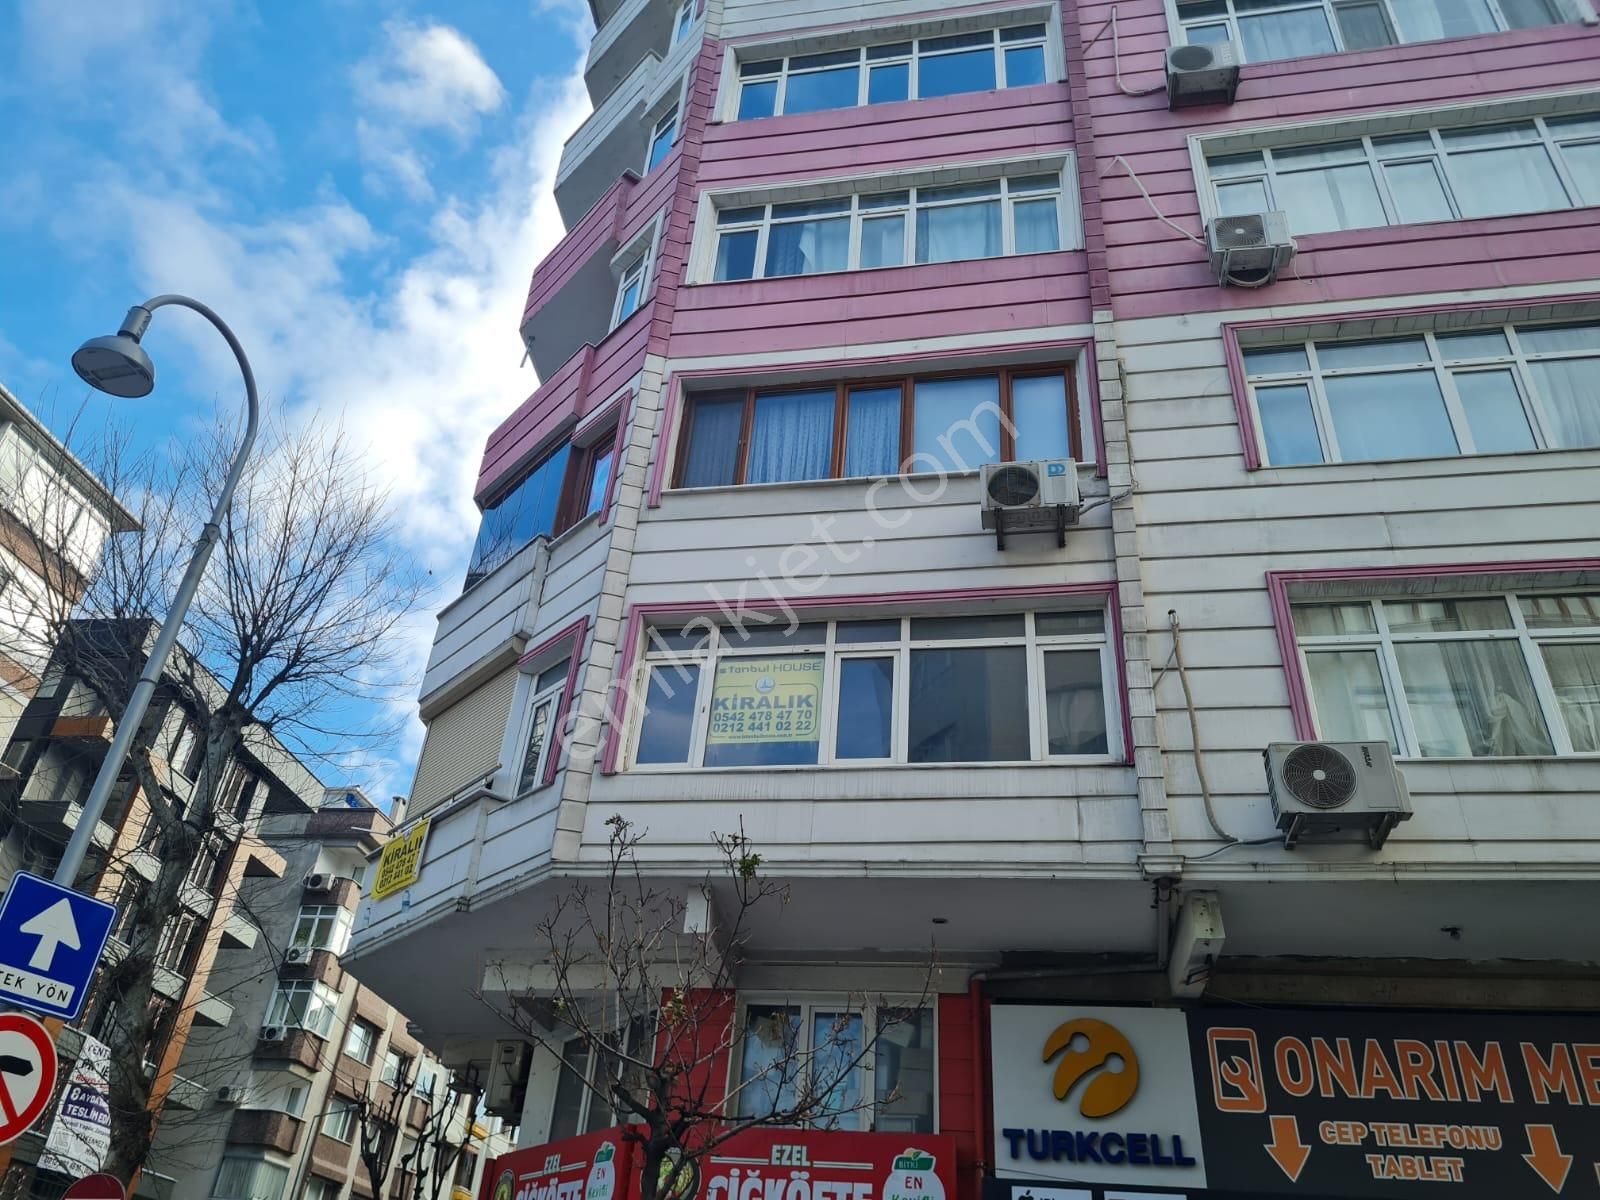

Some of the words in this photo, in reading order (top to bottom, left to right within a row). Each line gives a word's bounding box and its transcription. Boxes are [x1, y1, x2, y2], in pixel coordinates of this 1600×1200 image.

[773, 663, 821, 673] HOUSE
[714, 694, 814, 711] KİRALIK
[714, 712, 745, 722] 0542
[749, 711, 772, 721] 478
[777, 710, 793, 721] 47
[797, 710, 812, 720] 70
[713, 722, 744, 733] 0212
[748, 721, 771, 732] 441
[776, 720, 791, 731] 02
[796, 720, 811, 730] 22
[36, 982, 69, 1002] YÖN
[1273, 1035, 1514, 1103] ONARIM
[70, 1088, 82, 1101] 8
[67, 1103, 98, 1121] TESLİM
[1319, 1121, 1368, 1146] CEP
[1368, 1122, 1502, 1150] TELEFONU
[771, 1144, 811, 1167] EZEL
[1003, 1128, 1196, 1166] TURKCELL
[544, 1154, 561, 1175] EZEL
[596, 1167, 606, 1180] EN
[1366, 1154, 1464, 1182] TABLET
[905, 1175, 923, 1190] EN
